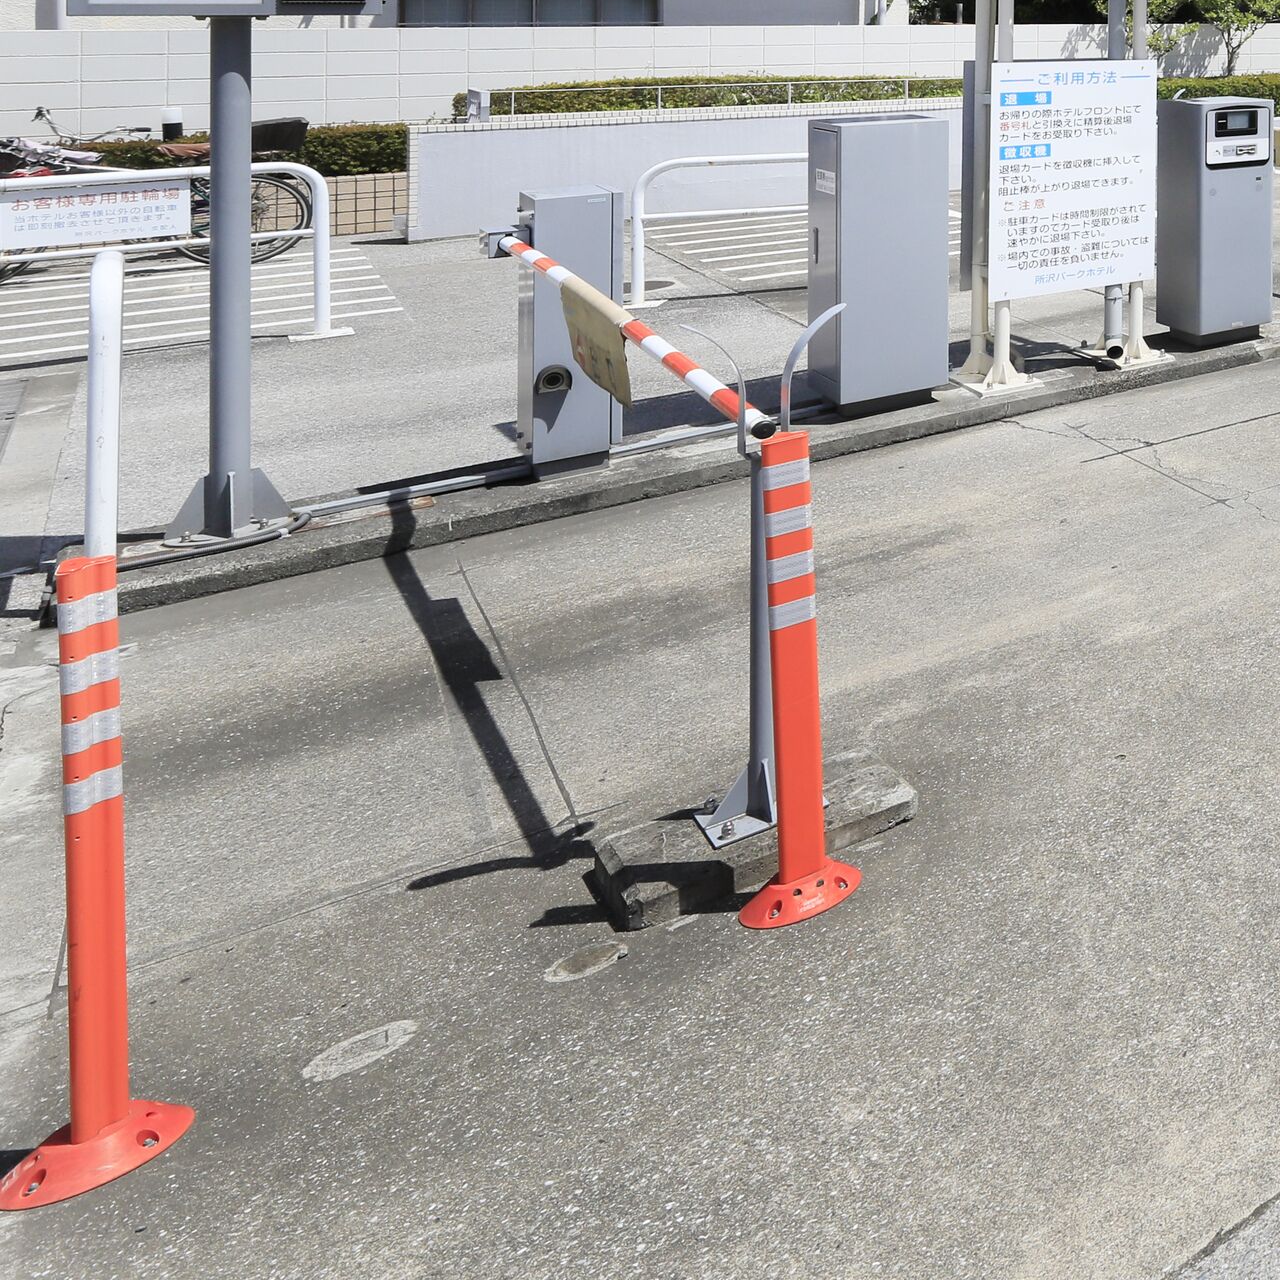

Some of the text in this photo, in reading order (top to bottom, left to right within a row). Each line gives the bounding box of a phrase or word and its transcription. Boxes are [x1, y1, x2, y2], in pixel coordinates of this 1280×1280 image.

[1037, 71, 1117, 86] ご利用方法
[1000, 105, 1142, 120] お帰りの際ホテルフロントにて
[1000, 116, 1132, 131] 番号札と引換えに精算後退場
[1000, 128, 1118, 142] カードをお受取り下さい。
[1000, 155, 1141, 174] 退場カードを徴収機に挿入して
[998, 177, 1134, 197] 阻止棒が上がり退場できます。
[1000, 175, 1037, 184] 下さい。
[11, 187, 180, 212] お客様専用駐輪場
[1003, 199, 1046, 212] ご注意
[14, 204, 177, 223] 当ホテルお客様以外の自転車
[1007, 215, 1140, 237] いますのでカード受取り後は
[1007, 230, 1106, 248] 速やかに退場下さい。
[1007, 250, 1125, 271] 一切の責任を負いません。
[1034, 265, 1116, 285] 所沢パークホテル
